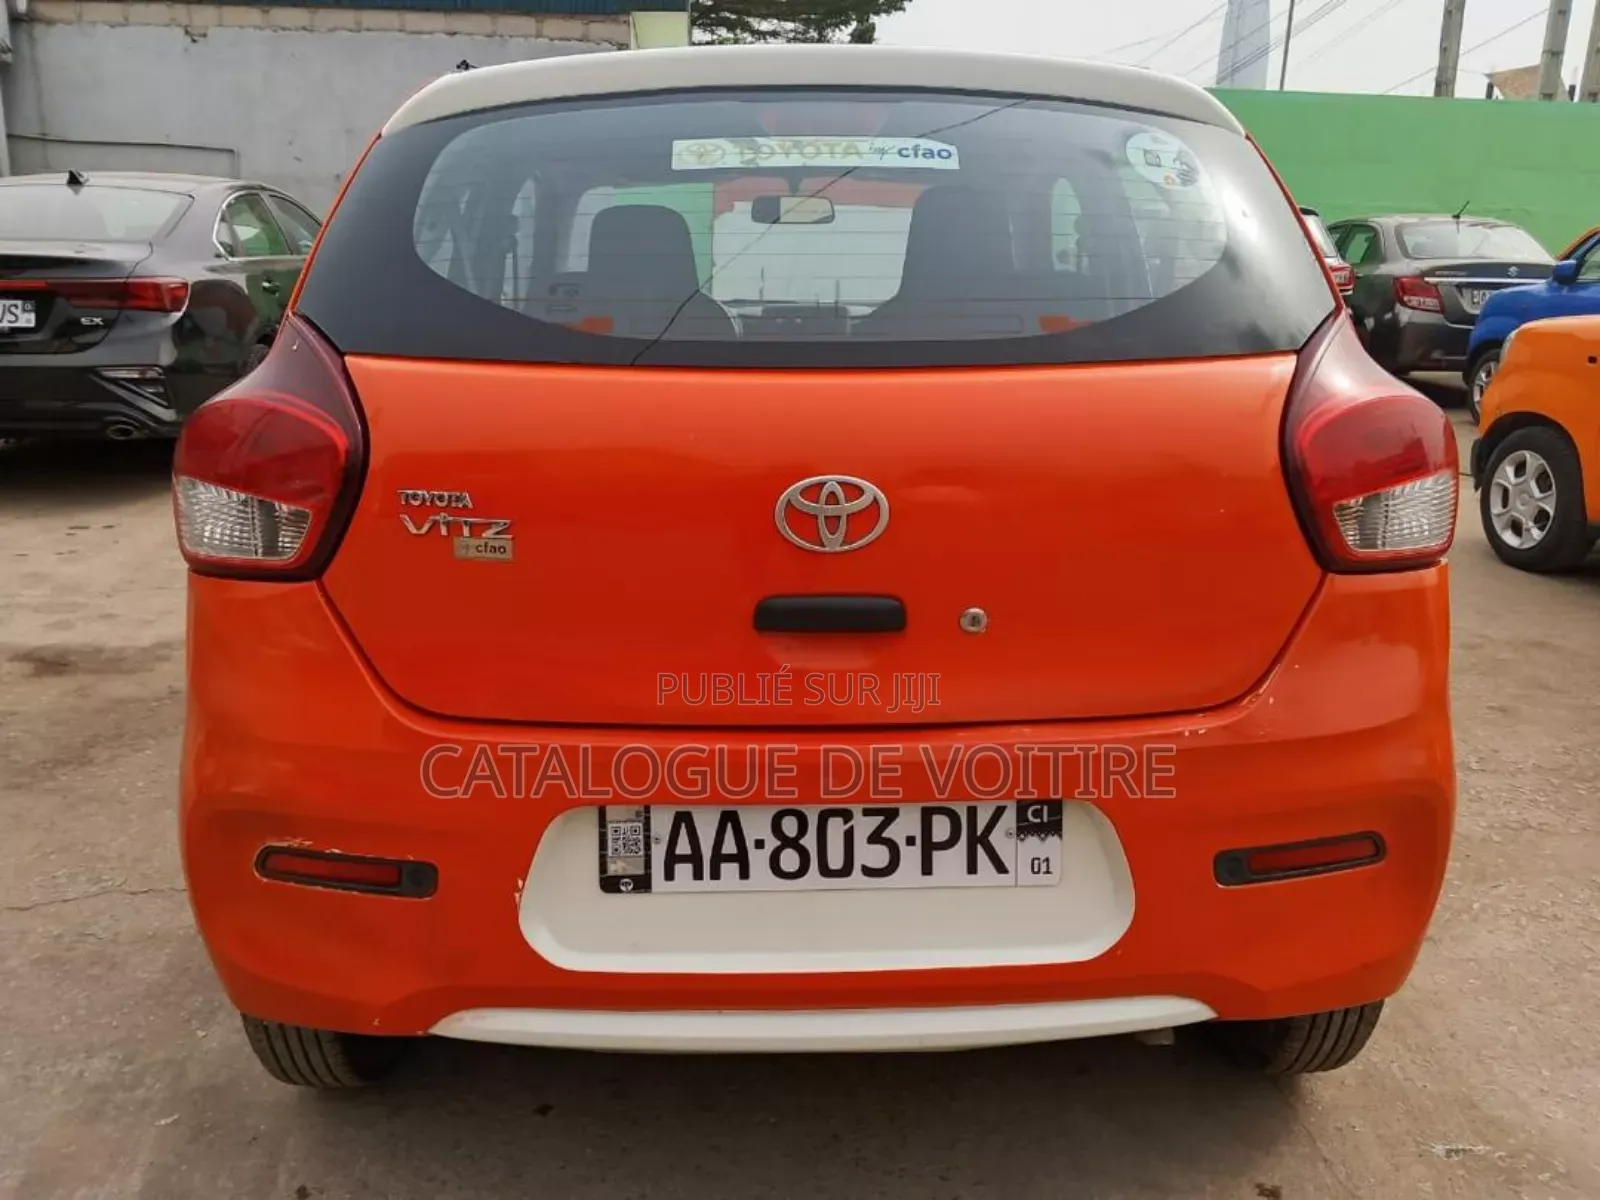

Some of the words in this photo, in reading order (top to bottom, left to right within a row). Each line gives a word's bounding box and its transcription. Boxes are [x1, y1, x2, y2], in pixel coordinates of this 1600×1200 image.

[898, 144, 952, 160] cfao
[80, 316, 104, 325] EX
[397, 489, 474, 509] TOYOTA
[475, 541, 507, 555] cfao
[1027, 804, 1048, 823] CI
[1030, 857, 1053, 875] 01
